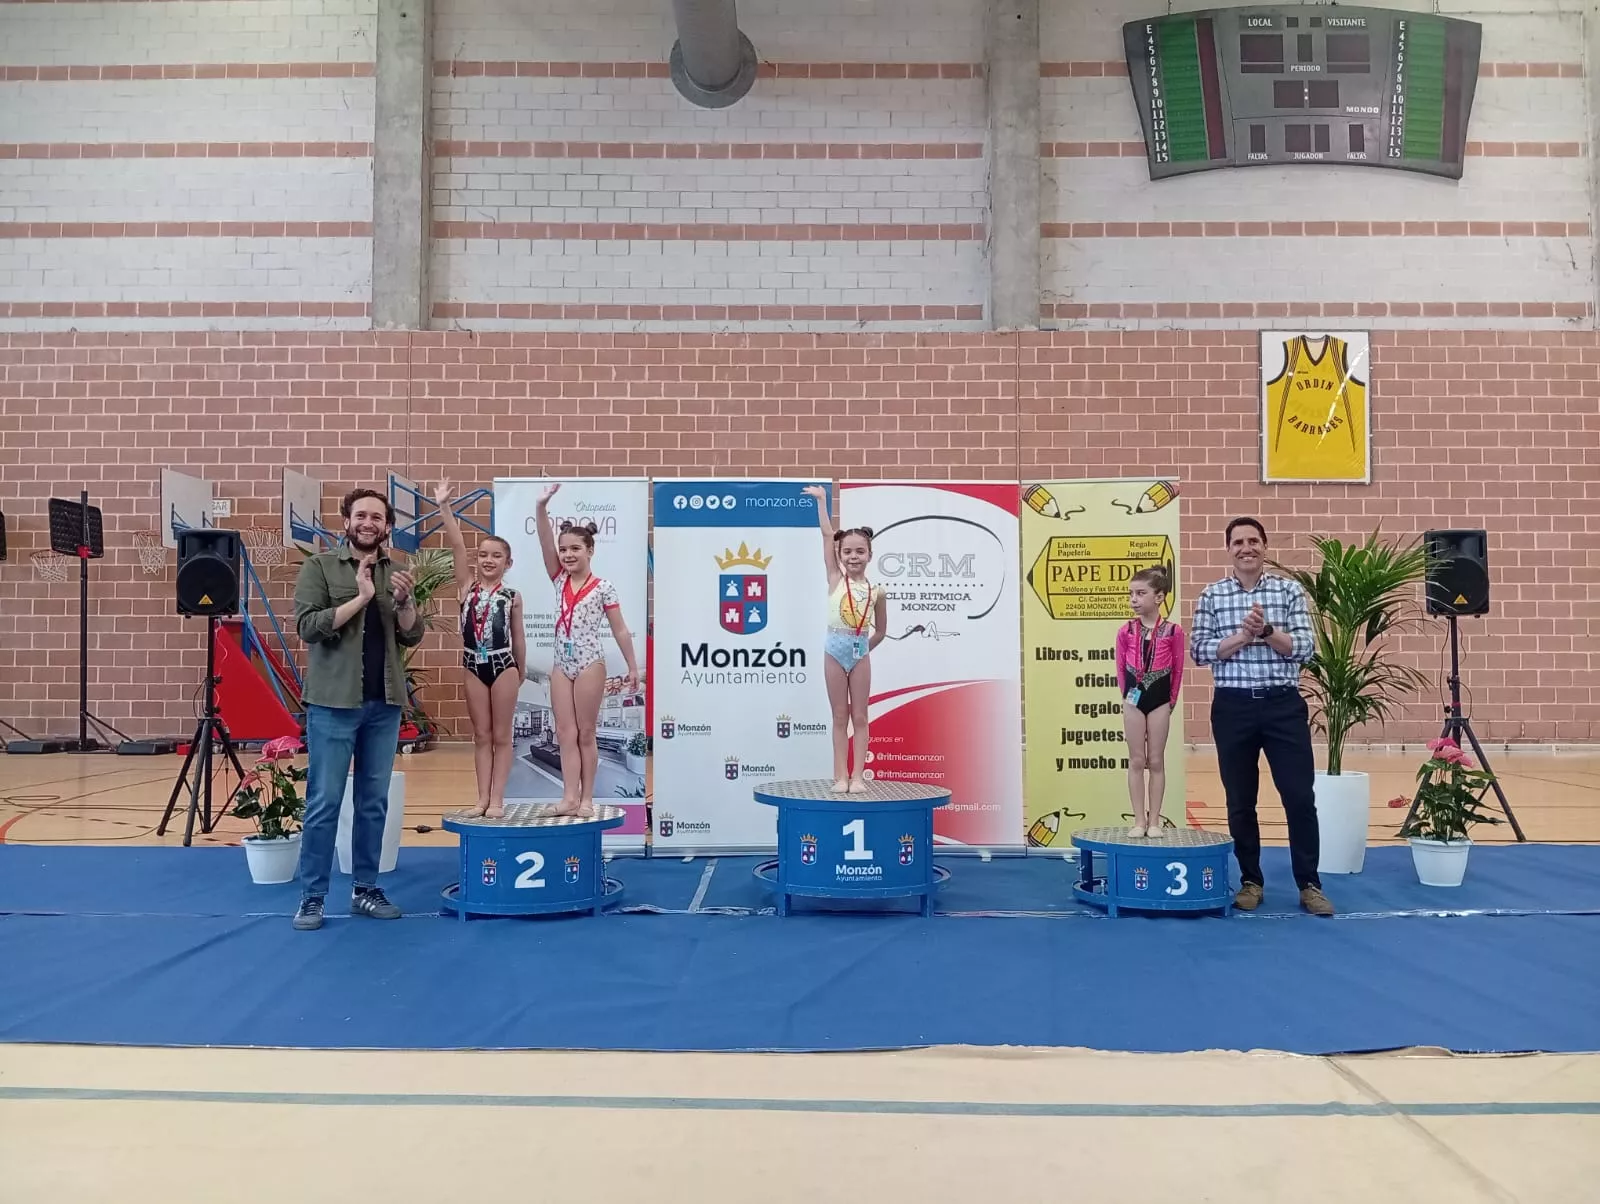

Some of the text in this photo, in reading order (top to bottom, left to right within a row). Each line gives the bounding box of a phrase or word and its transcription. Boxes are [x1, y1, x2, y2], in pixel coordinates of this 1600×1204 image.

[1248, 18, 1273, 27] LOCAL
[1327, 18, 1367, 27] VISITANTE
[1400, 21, 1405, 30] E
[1146, 25, 1152, 34] E
[1148, 36, 1154, 44] 4
[1399, 32, 1405, 40] 4
[1149, 46, 1154, 55] 5
[1399, 42, 1404, 51] 5
[1150, 56, 1156, 65] 6
[1398, 53, 1403, 61] 6
[1151, 67, 1156, 76] 7
[1397, 63, 1403, 72] 7
[1152, 78, 1157, 86] 8
[1397, 74, 1402, 82] 8
[1153, 89, 1159, 97] 9
[1396, 84, 1402, 93] 9
[1152, 99, 1162, 108] 10
[1392, 95, 1404, 104] 10
[1346, 106, 1379, 114] MONDO
[1392, 105, 1402, 114] 11
[1153, 110, 1164, 119] 11
[1391, 116, 1402, 125] 12
[1154, 121, 1164, 130] 12
[1390, 126, 1401, 135] 13
[1155, 132, 1166, 140] 13
[1156, 142, 1166, 151] 14
[1293, 152, 1324, 160] JUGADOR
[1346, 152, 1367, 160] FALTAS
[1389, 148, 1400, 157] 15
[1157, 153, 1168, 162] 15
[745, 495, 813, 508] monzon.es
[1130, 540, 1158, 549] Regalos
[1126, 550, 1159, 558] Juguetes
[878, 552, 976, 578] CRM
[1051, 564, 1153, 583] PAPE IDE
[885, 592, 972, 601] CLUB RITMICA
[901, 603, 956, 612] MONZON
[681, 642, 806, 668] Monzón
[1035, 646, 1115, 662] Libros, mat
[681, 670, 807, 688] Ayuntamiento
[1075, 673, 1118, 688] oficin
[793, 723, 827, 731] Monzón
[876, 752, 945, 761] @ritmicamonzon
[742, 764, 775, 772] Monzón
[1056, 758, 1064, 772] y
[1068, 755, 1116, 769] mucho
[876, 770, 945, 778] @ritmicamonzon
[842, 819, 874, 860] 1
[514, 851, 546, 889] 2
[836, 864, 883, 875] Monzón
[1165, 862, 1189, 896] 3
